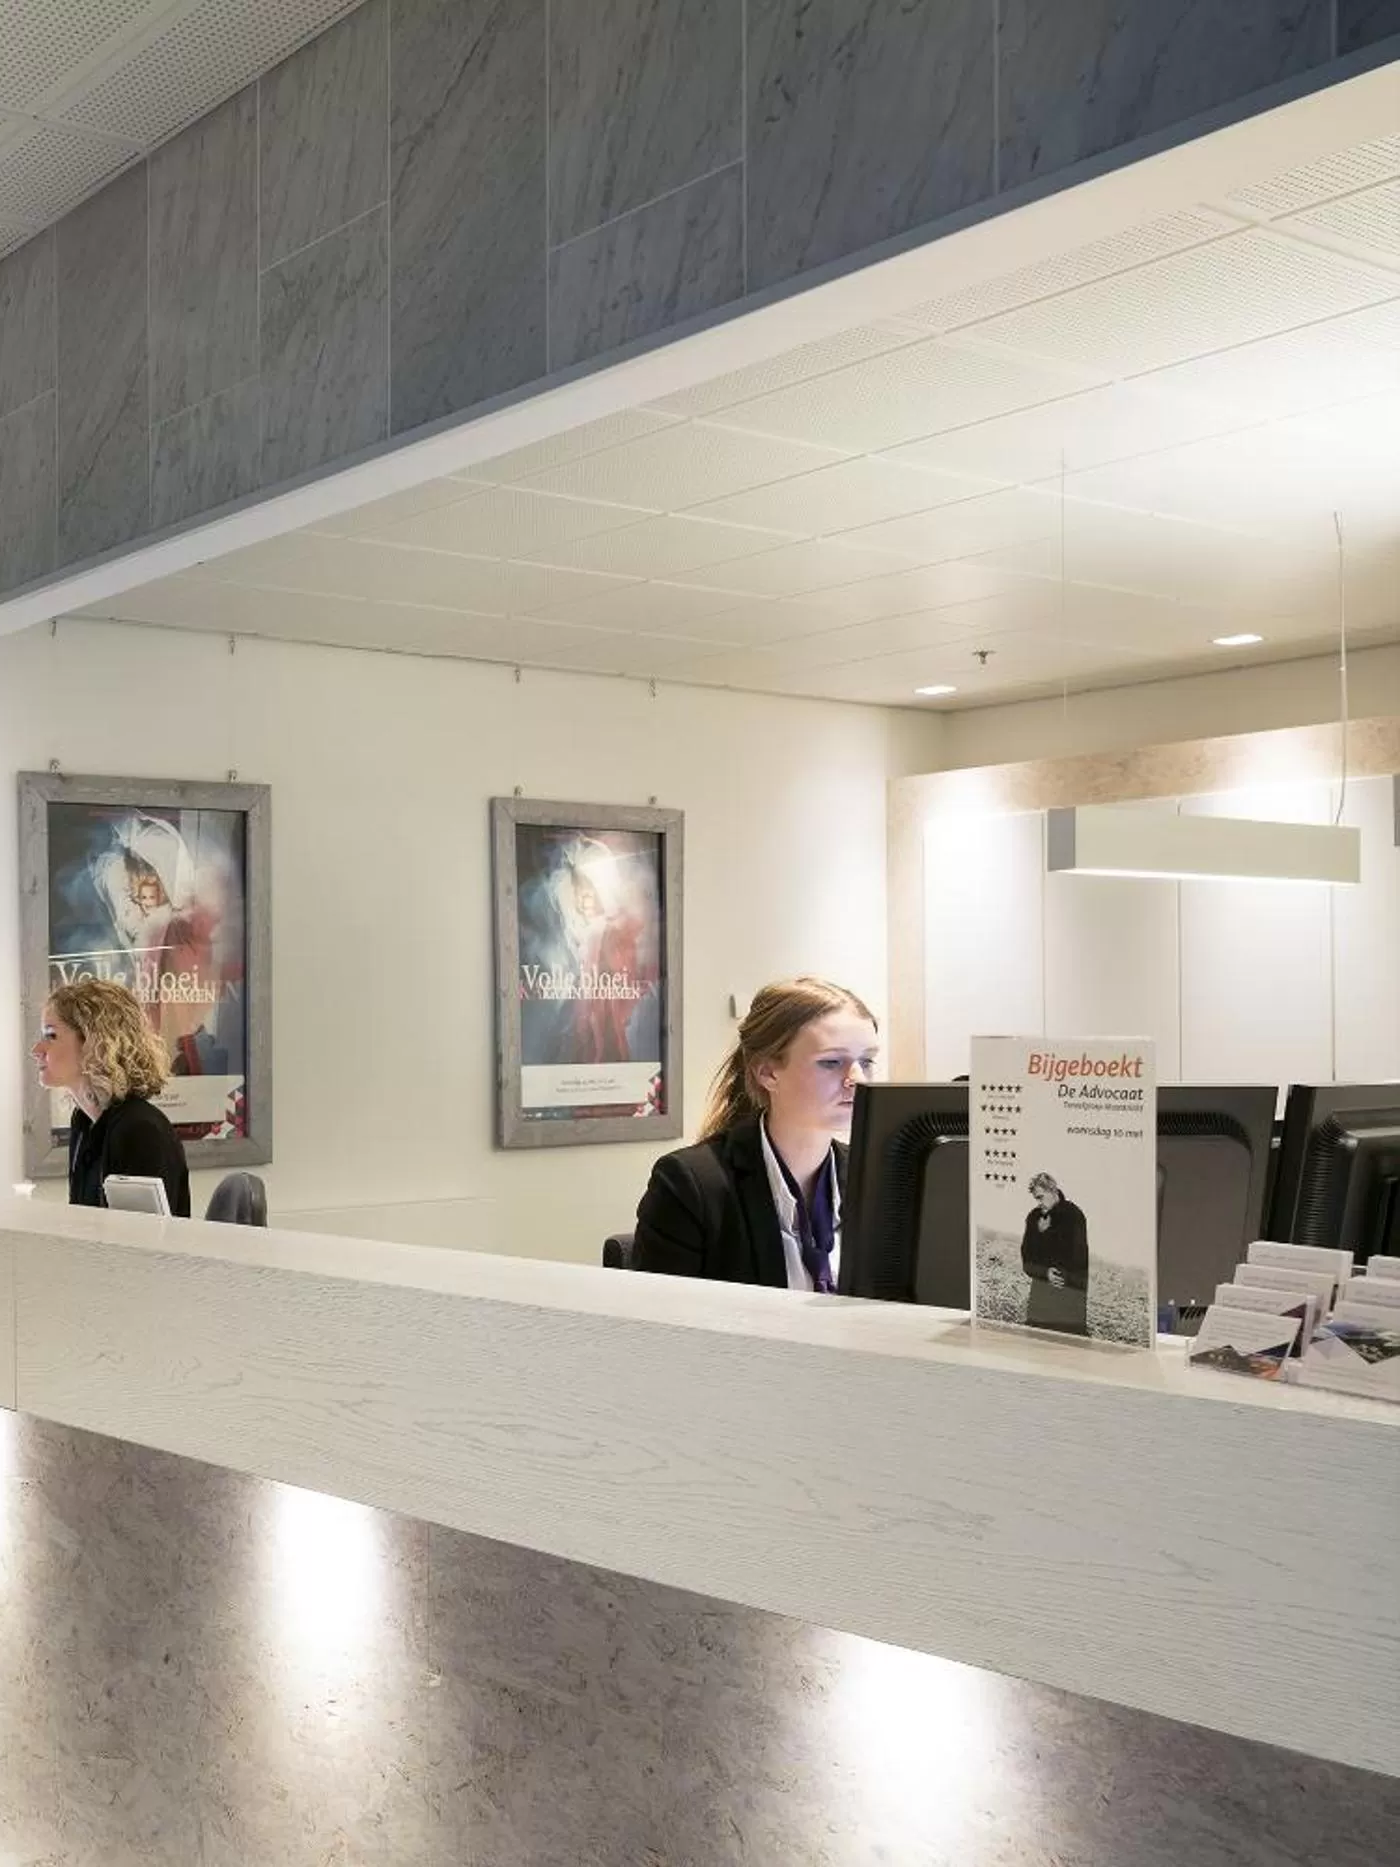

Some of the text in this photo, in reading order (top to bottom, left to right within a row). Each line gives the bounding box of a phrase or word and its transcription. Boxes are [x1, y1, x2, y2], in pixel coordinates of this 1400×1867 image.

[133, 961, 199, 991] bloei
[521, 963, 630, 990] Volle bloei
[141, 988, 216, 1003] BLOEMEN
[1028, 1053, 1144, 1081] Bijgeboekt
[1057, 1084, 1144, 1101] De Advocaat
